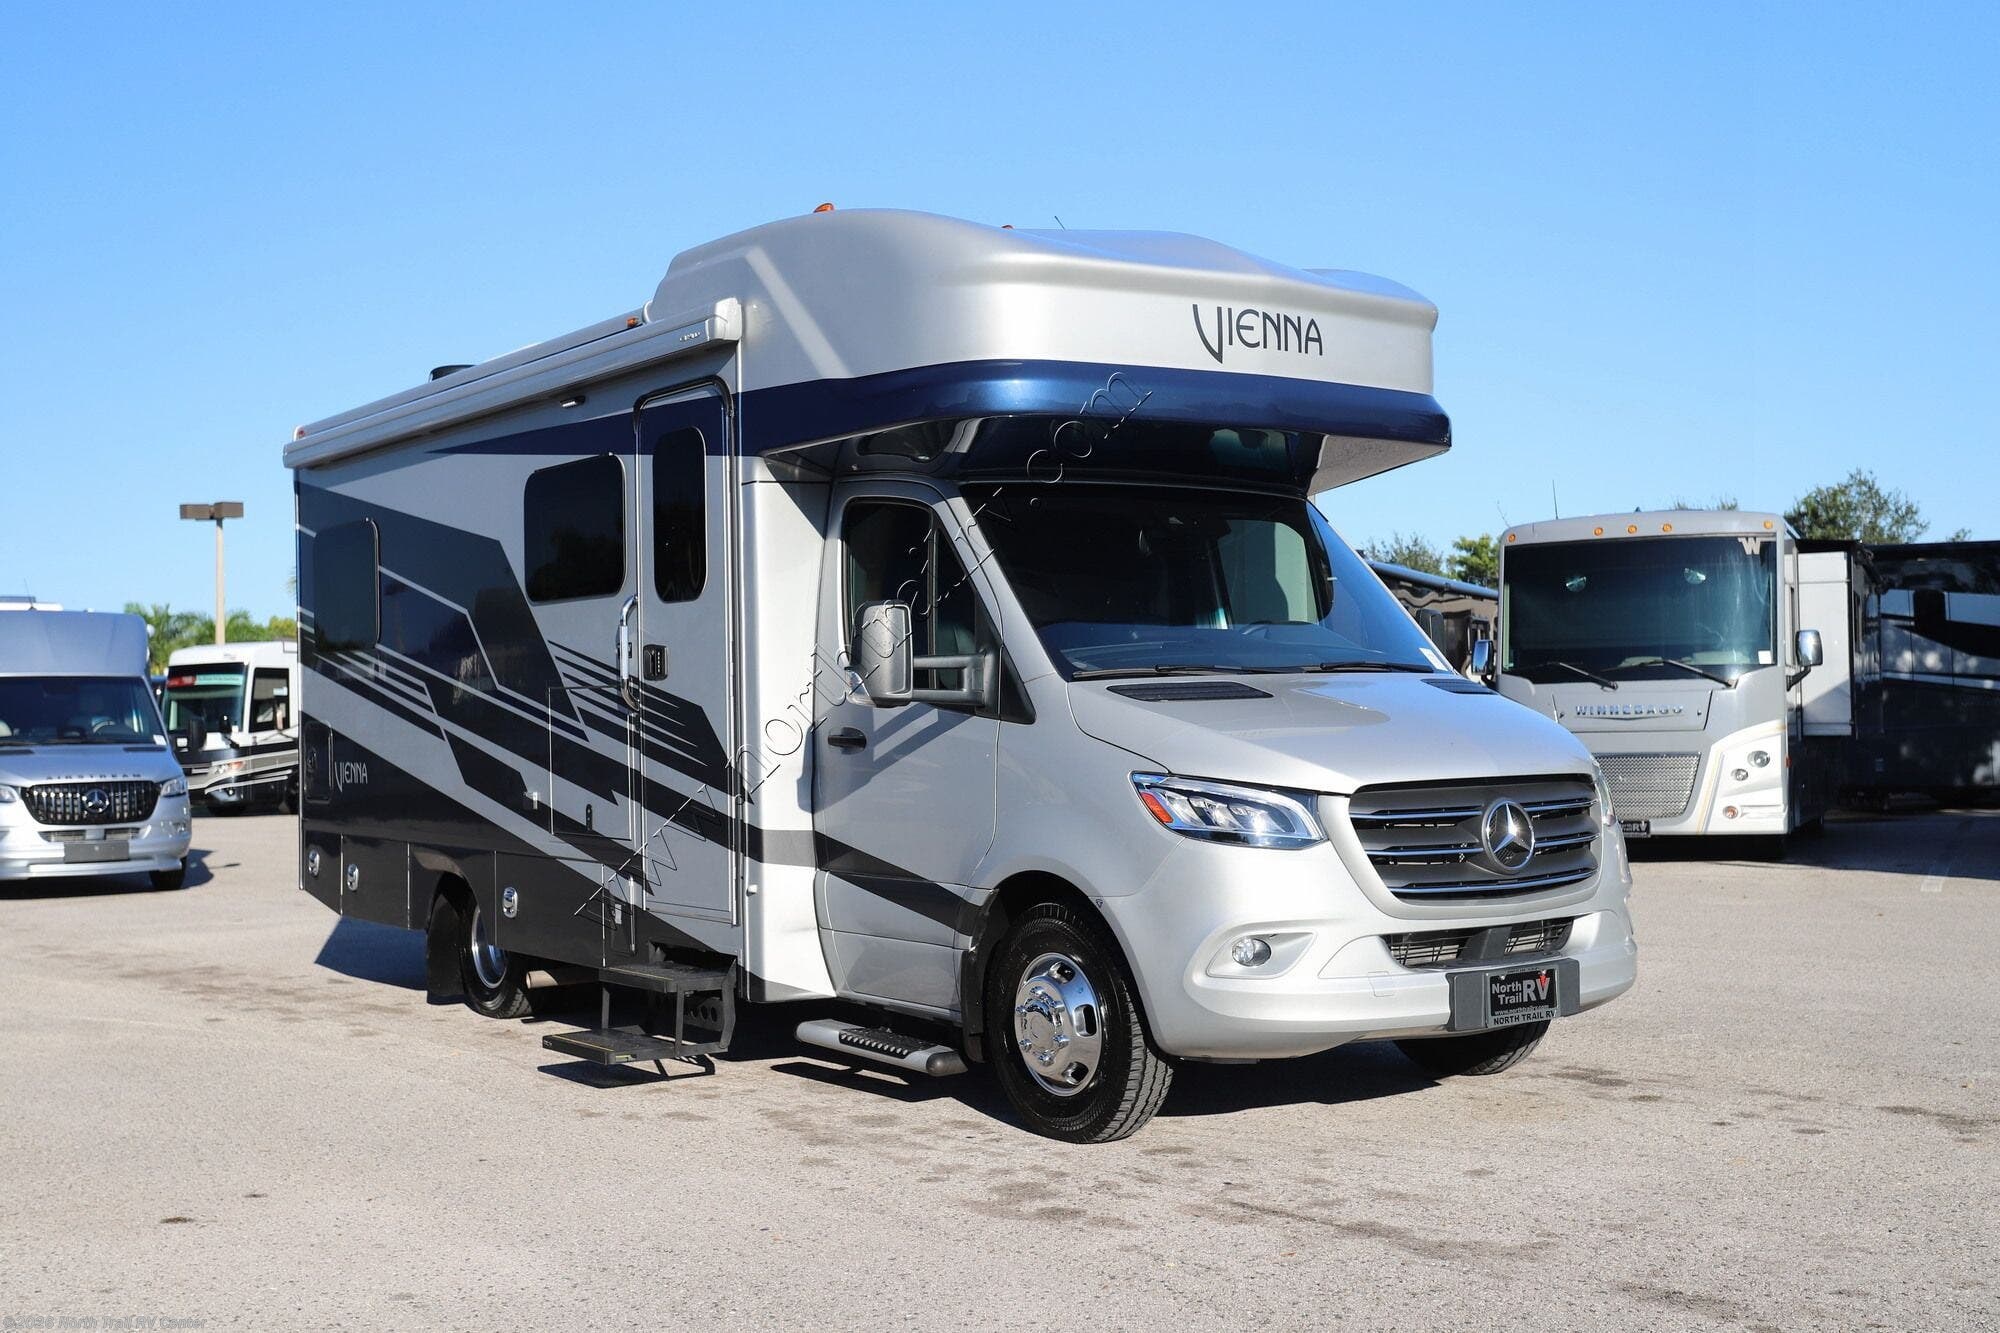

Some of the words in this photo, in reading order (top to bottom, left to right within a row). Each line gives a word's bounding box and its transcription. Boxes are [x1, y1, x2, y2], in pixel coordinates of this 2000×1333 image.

[1192, 303, 1323, 364] VIENNA
[1575, 704, 1683, 716] WINNEBAGO
[334, 761, 368, 793] VIENNA
[1492, 981, 1522, 994] North
[1522, 978, 1550, 1002] RV
[1498, 992, 1522, 1005] Trail
[1493, 1015, 1520, 1025] NORTH
[1522, 1011, 1544, 1020] TRAIL
